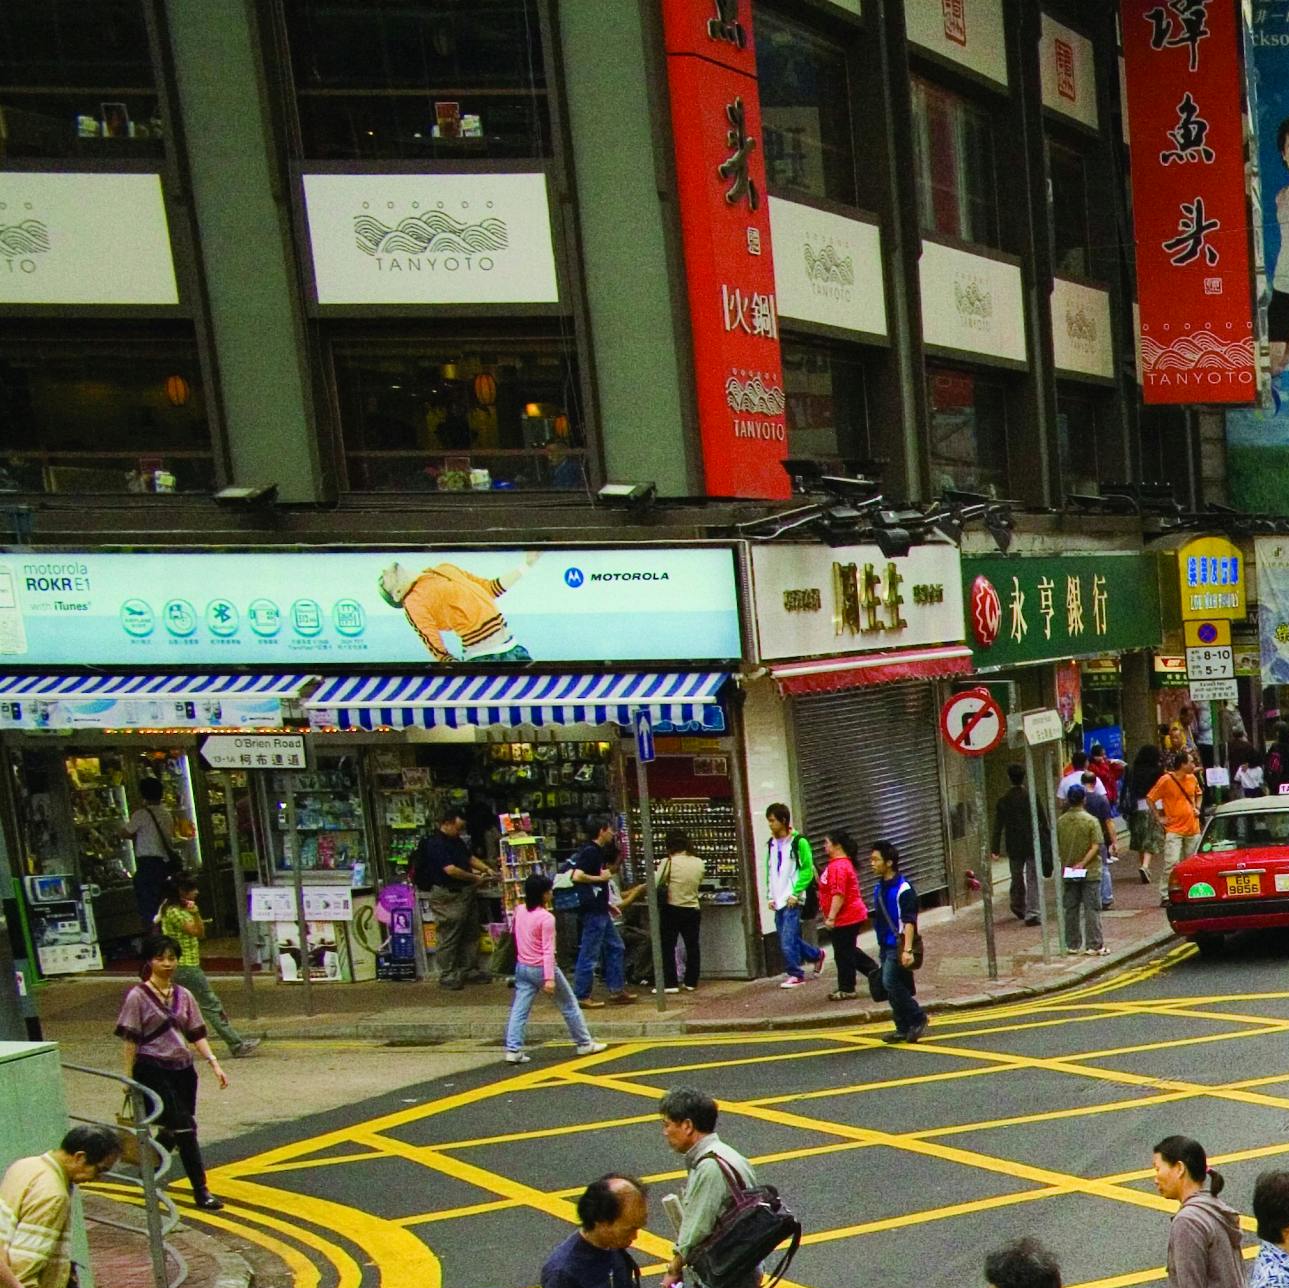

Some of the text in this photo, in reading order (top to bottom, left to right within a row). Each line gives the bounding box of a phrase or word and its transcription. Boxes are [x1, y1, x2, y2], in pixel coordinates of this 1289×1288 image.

[375, 256, 495, 272] TANYOTO
[1148, 372, 1253, 386] TANYOTO
[733, 419, 784, 442] TANYOTO
[24, 563, 88, 576] motorola
[590, 572, 670, 582] MOTOROLA
[26, 577, 91, 592] ROKR E1
[54, 601, 88, 611] iTunes
[1008, 573, 1108, 644] 永亨銀行
[1204, 649, 1231, 661] 8-10
[1205, 664, 1228, 675] 5-7
[234, 738, 302, 749] O'Brien Road
[1235, 875, 1251, 885] EG
[1229, 884, 1260, 895] 9856
